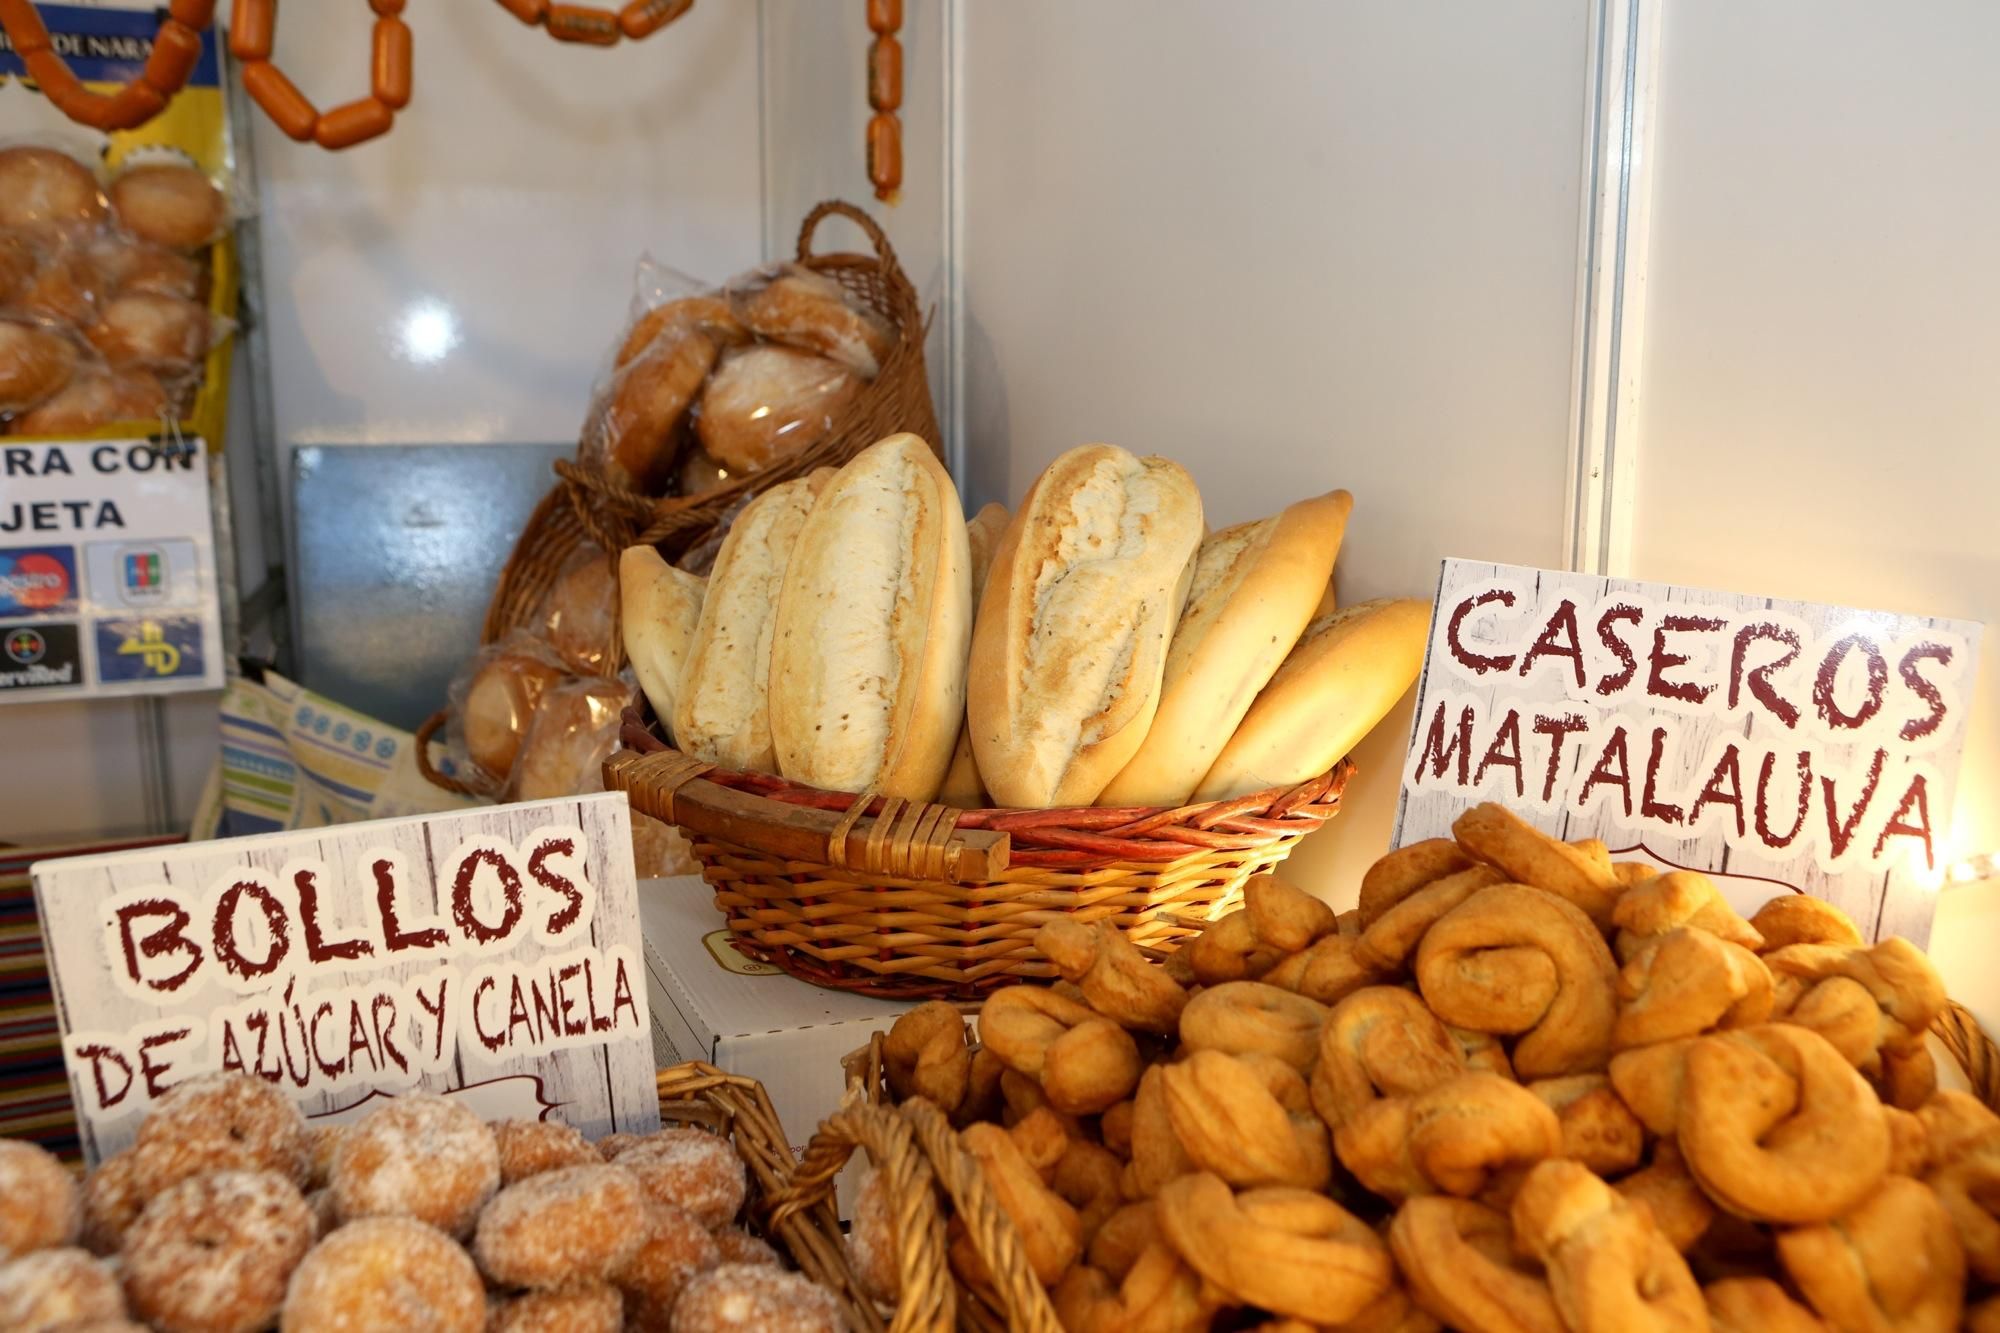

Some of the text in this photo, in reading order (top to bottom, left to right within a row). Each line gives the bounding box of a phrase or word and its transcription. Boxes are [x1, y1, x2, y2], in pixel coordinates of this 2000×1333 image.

[0, 500, 125, 532] JETA
[91, 445, 192, 473] CON
[1447, 589, 1953, 741] CASEROS
[1415, 700, 1934, 870] MATALAUVA
[116, 838, 583, 992] BOLLOS
[76, 1028, 191, 1109] DE
[223, 975, 408, 1088] AZÚCAR
[417, 978, 447, 1060] Y
[473, 957, 638, 1052] CANELA
